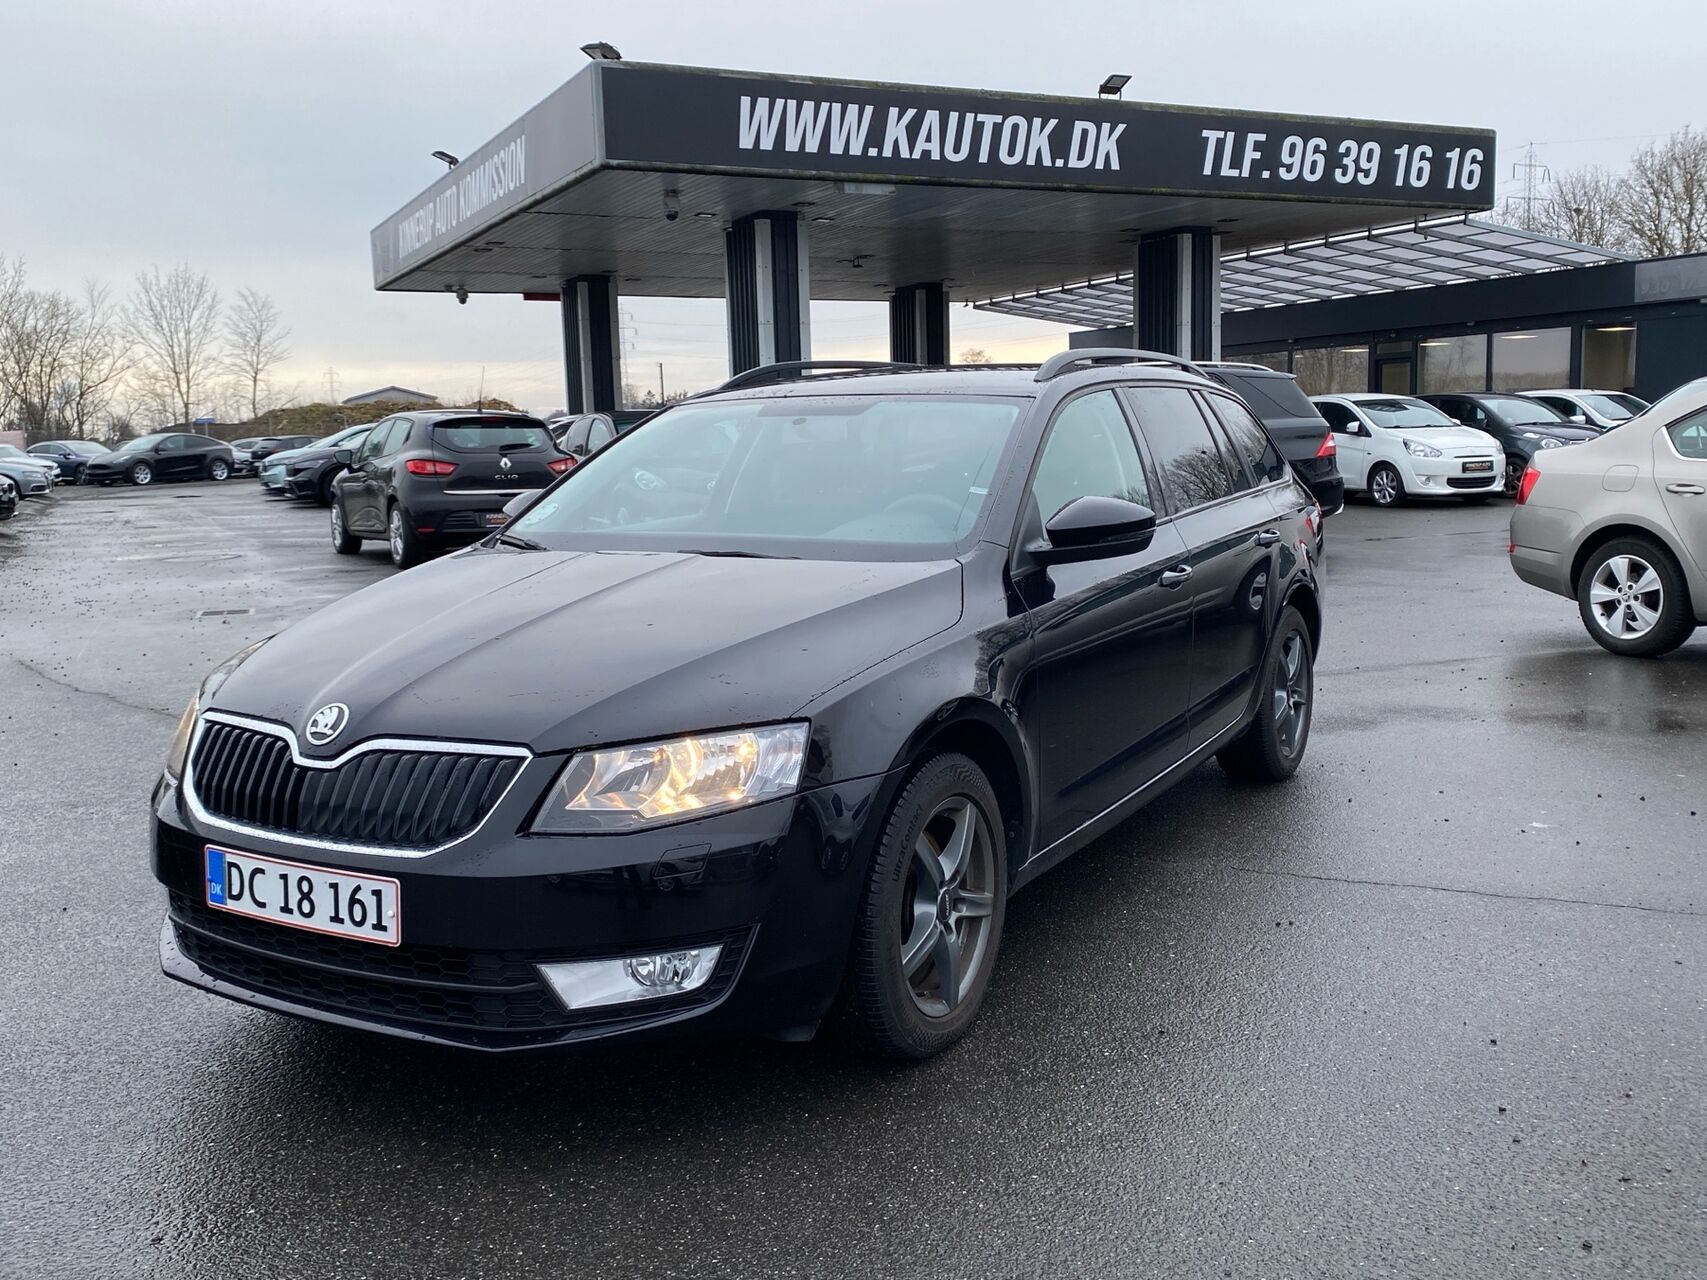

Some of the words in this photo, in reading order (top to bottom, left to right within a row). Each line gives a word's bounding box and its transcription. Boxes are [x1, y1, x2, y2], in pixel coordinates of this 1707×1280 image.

[738, 95, 1127, 171] WWW.KAUTOK.DK
[1201, 129, 1271, 179] TLF.
[1278, 134, 1328, 183] 96
[1334, 138, 1381, 186] 39
[1394, 143, 1434, 188] 16
[1445, 147, 1485, 191] 16
[435, 184, 457, 237] AUTO
[458, 135, 526, 222] KOMMISSION
[210, 882, 222, 896] DK
[226, 861, 267, 909] DC
[278, 873, 316, 919] 18
[328, 882, 388, 932] 161
